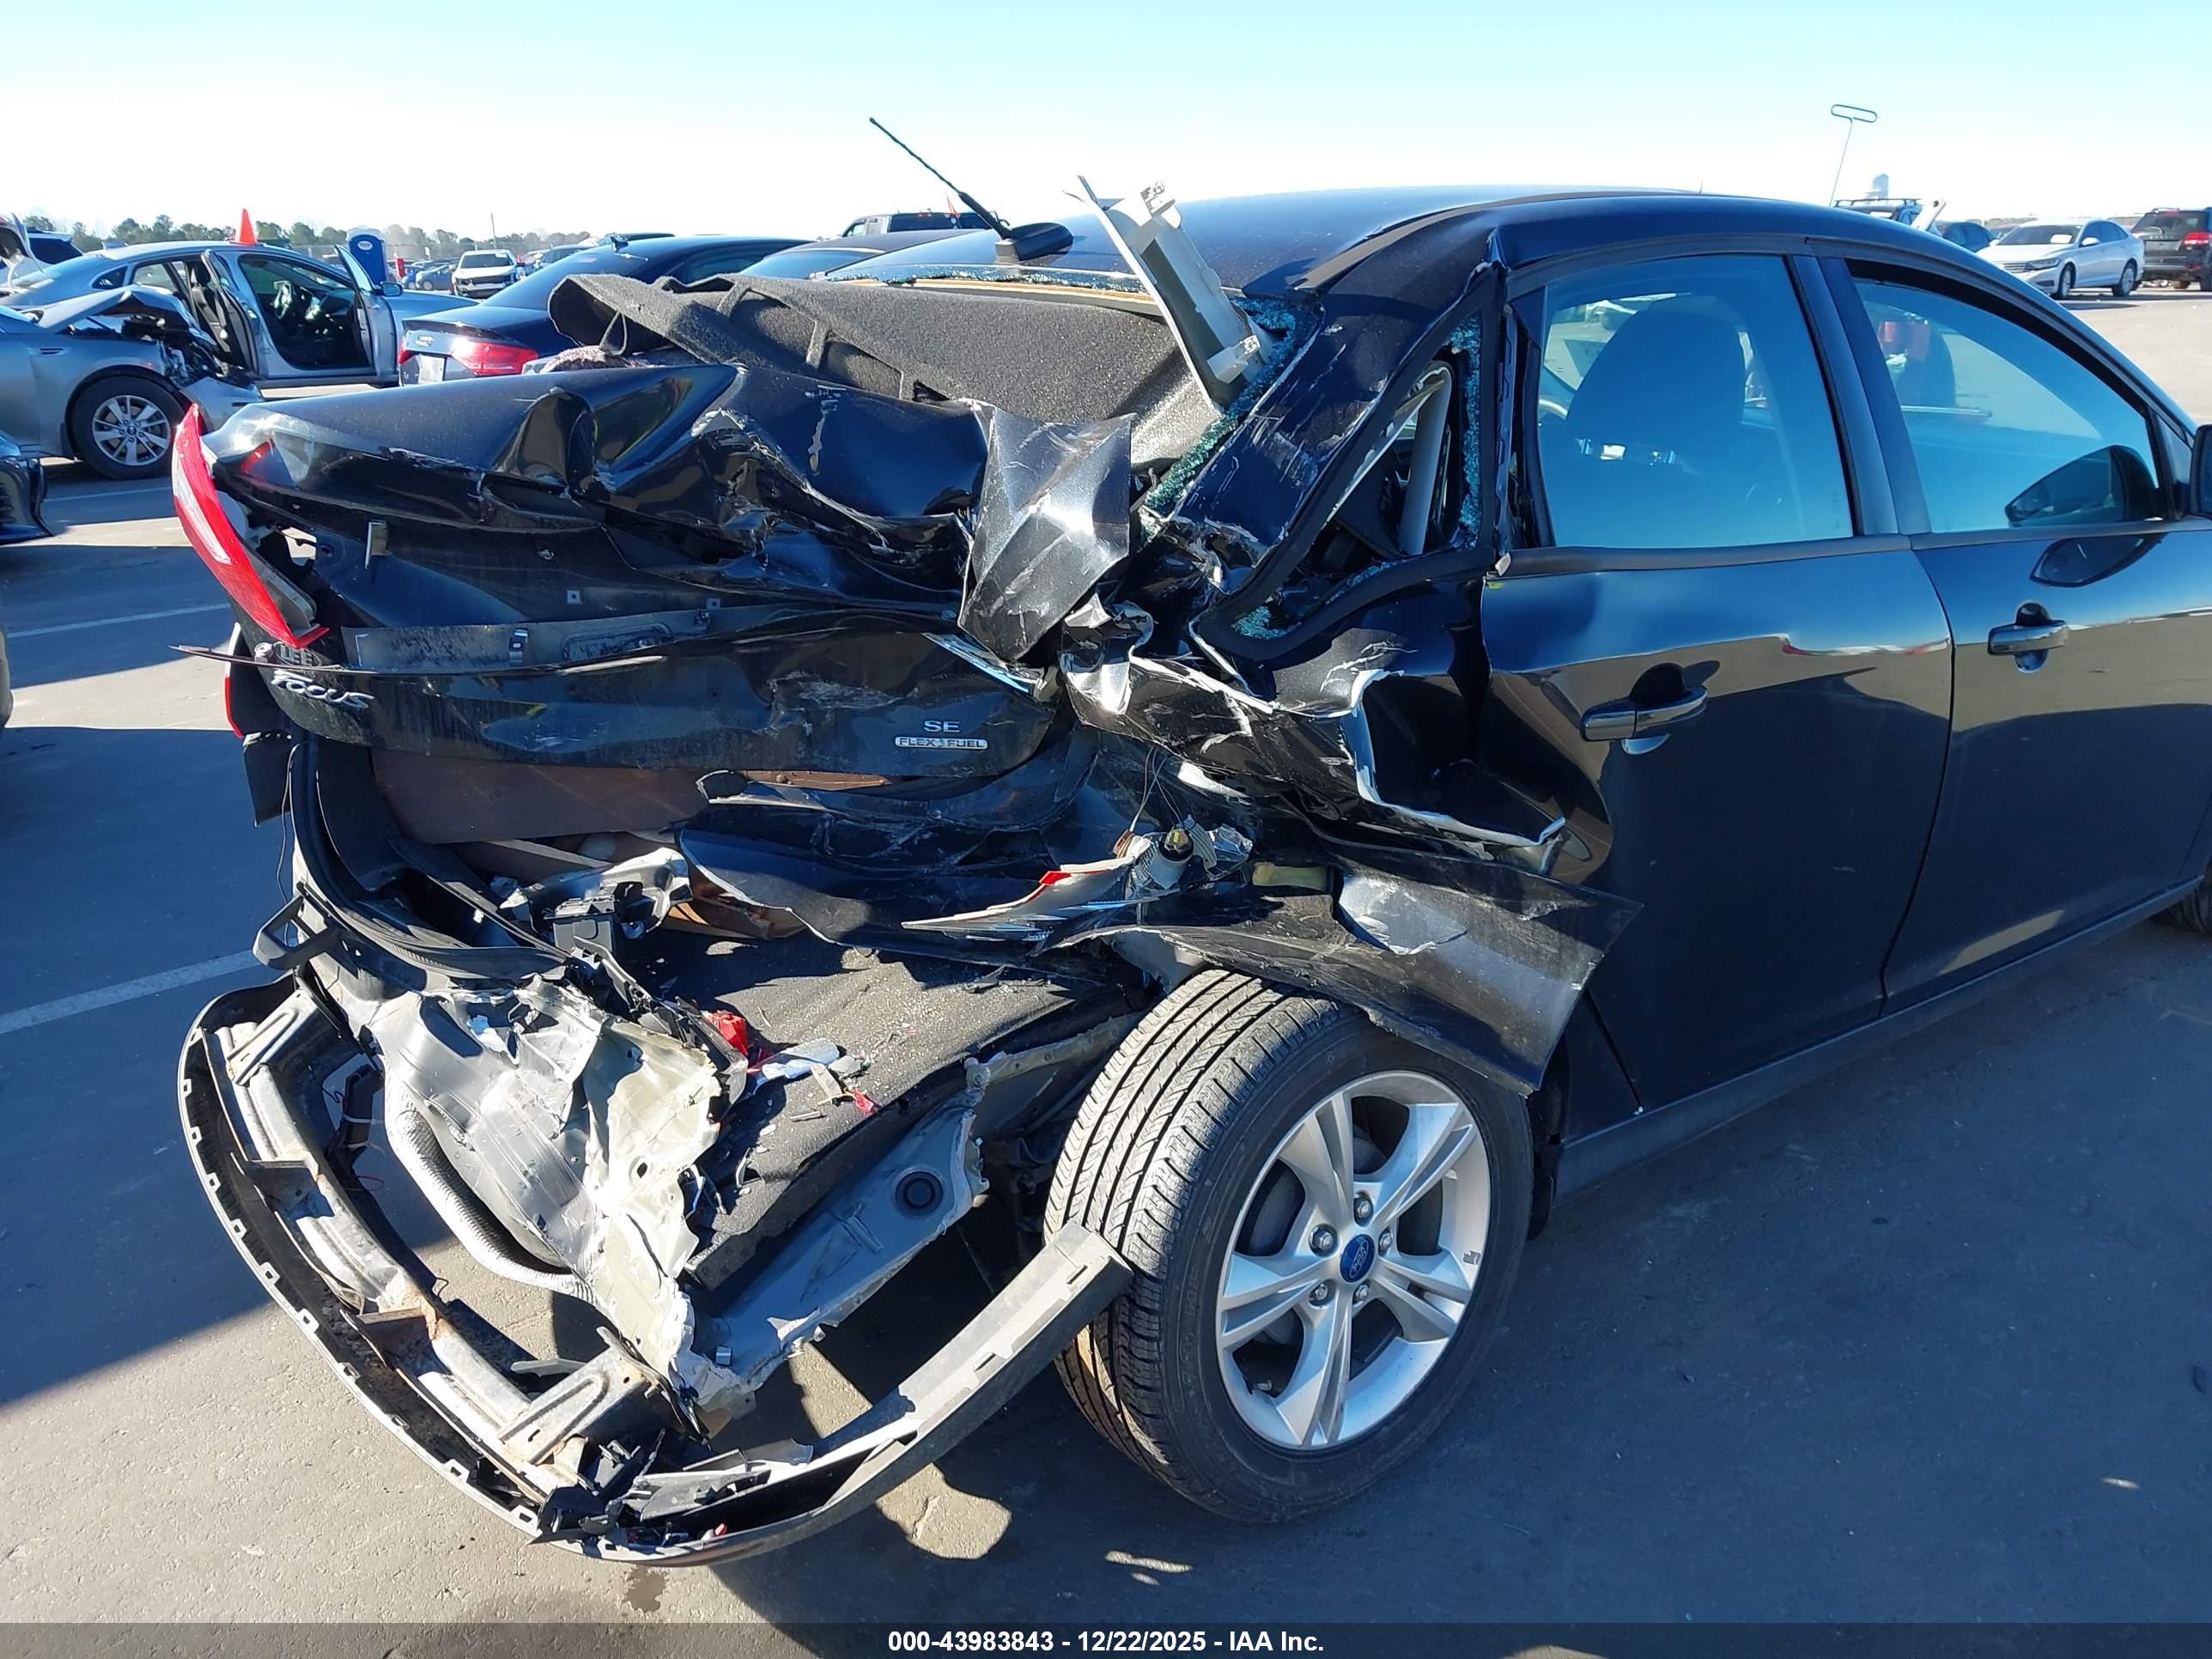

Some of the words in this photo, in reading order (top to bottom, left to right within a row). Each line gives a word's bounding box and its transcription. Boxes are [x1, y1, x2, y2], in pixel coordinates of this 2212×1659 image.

[923, 720, 960, 732] SE
[899, 738, 936, 747] FLEX
[947, 739, 986, 748] FUEL
